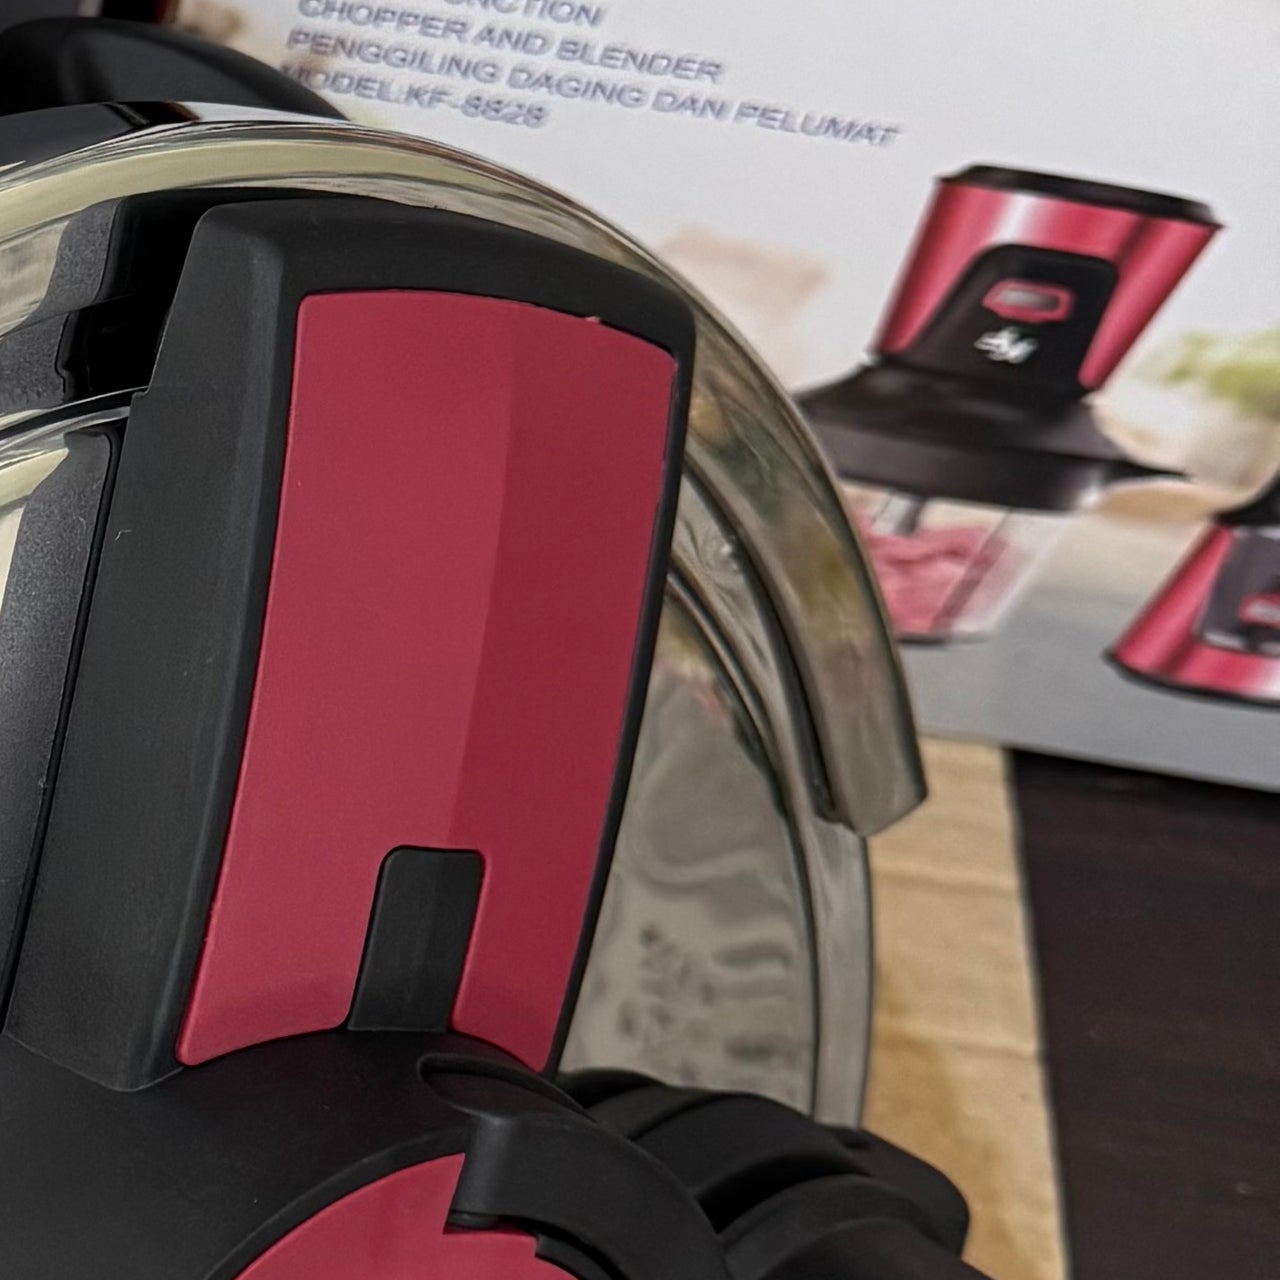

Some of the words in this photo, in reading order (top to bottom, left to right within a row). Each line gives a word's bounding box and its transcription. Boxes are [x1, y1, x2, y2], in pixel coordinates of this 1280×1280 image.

[286, 26, 500, 86] PENGGILING
[505, 65, 645, 112] DAGING
[650, 86, 729, 123] DAN
[733, 99, 902, 150] PELUMAT
[471, 23, 553, 58] AND
[554, 34, 725, 85] BLENDER
